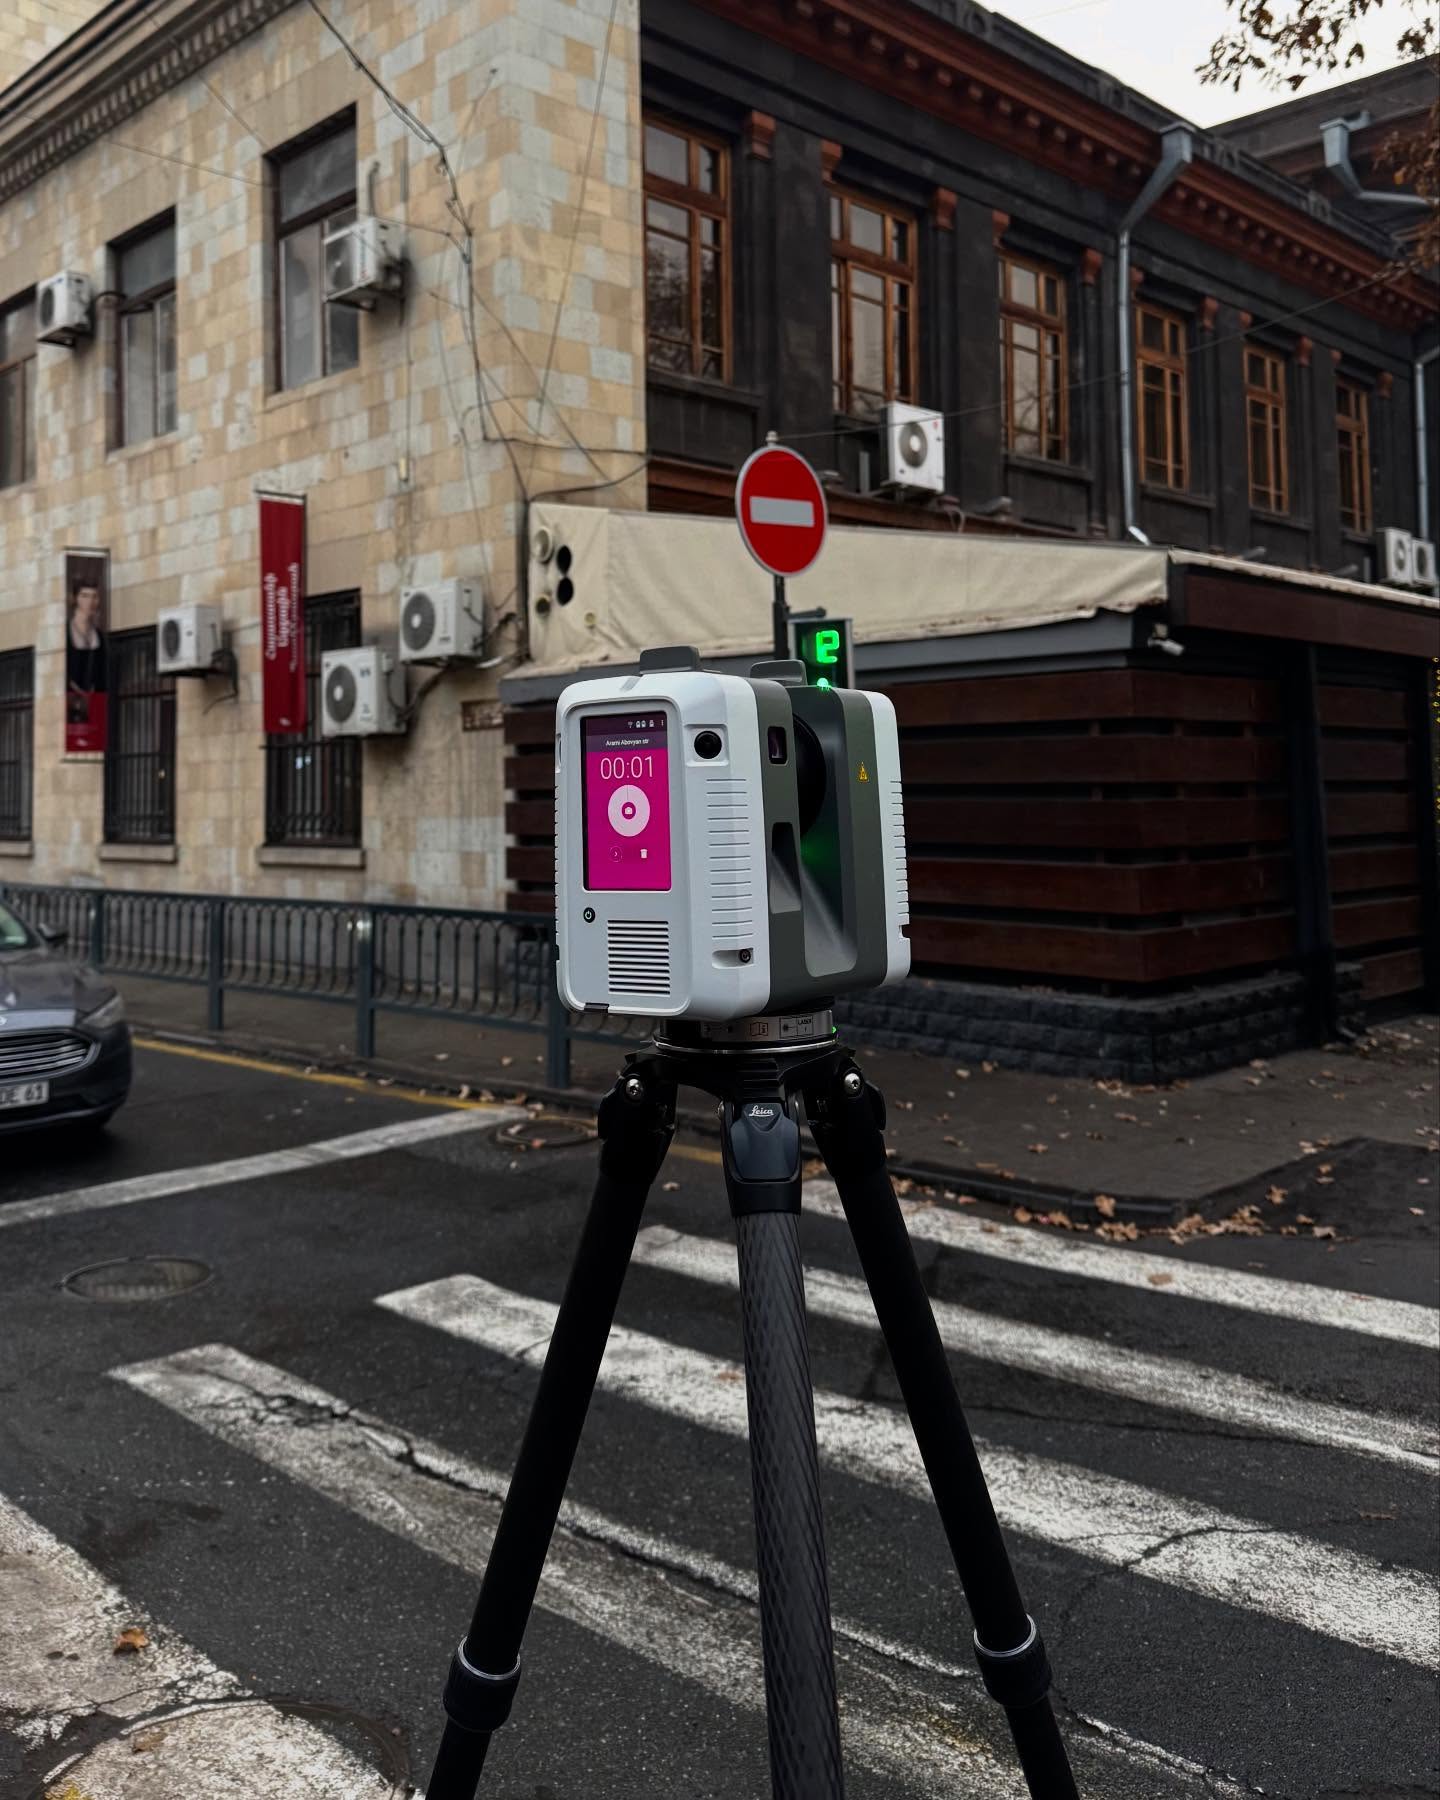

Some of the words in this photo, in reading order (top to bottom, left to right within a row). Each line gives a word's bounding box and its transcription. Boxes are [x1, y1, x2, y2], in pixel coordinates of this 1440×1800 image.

[621, 739, 641, 747] Abovyan
[600, 756, 653, 779] 00:01
[24, 1084, 42, 1101] 61
[748, 1105, 774, 1117] Leica
